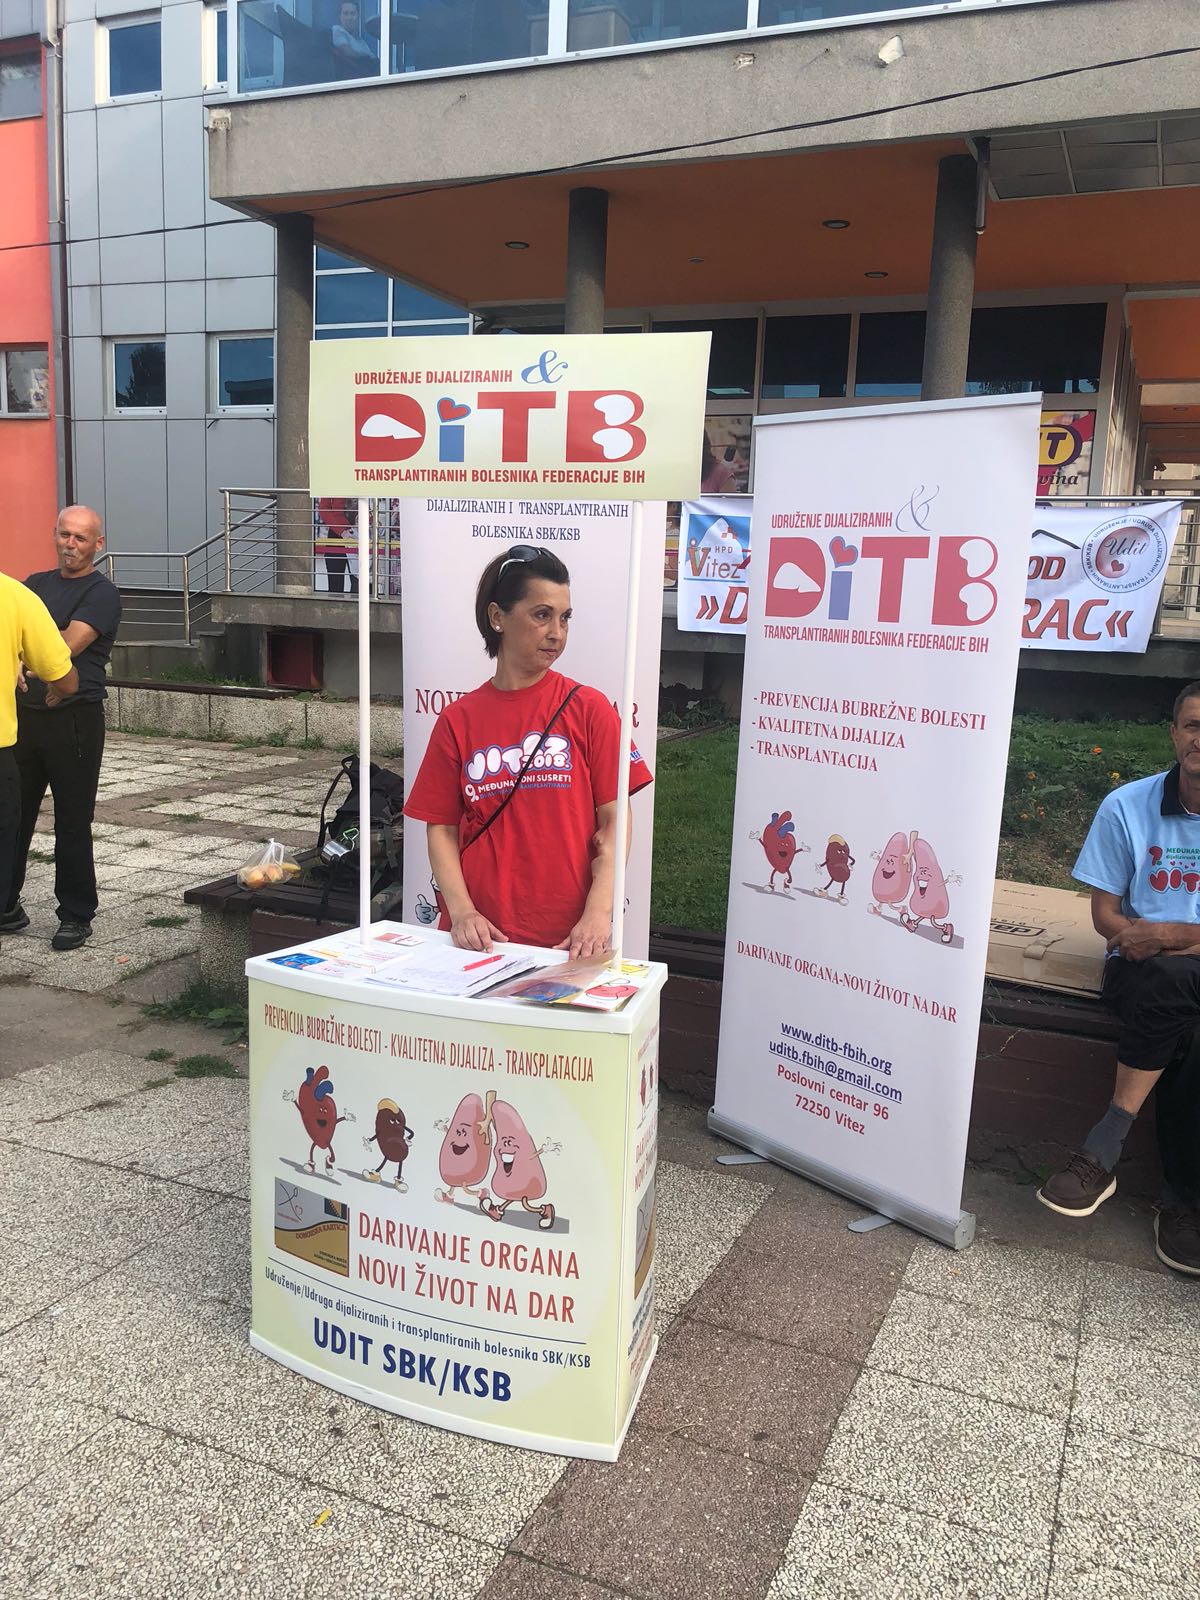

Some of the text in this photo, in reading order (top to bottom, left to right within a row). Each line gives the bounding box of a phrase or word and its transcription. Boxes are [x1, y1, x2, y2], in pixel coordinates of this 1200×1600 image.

[355, 368, 422, 384] UDRUŽENJE
[426, 369, 512, 384] DIJALIZIRANIH
[355, 468, 646, 484] TRANSPLANTIRANIH BOLESNIKA FEDERACIJE BIH
[426, 499, 629, 518] DIJALIZIRANIH I TRANSPLANTIRANIH
[772, 509, 822, 528] UDRUŽENJE
[824, 512, 893, 528] DIJALIZIRANIH
[472, 524, 580, 541] BOLESNIKA SBK/KSB
[1104, 537, 1147, 556] Udit
[688, 547, 741, 578] Vitez
[764, 625, 989, 653] TRANSPLANTIRANIH BOLESNIKA FEDERACIJE BIH
[760, 691, 838, 714] PREVENCIJA
[842, 700, 916, 722] BUBREŽNE
[920, 708, 987, 731] BOLESTI
[758, 716, 838, 740] KVALITETNA
[841, 726, 906, 749] DIJALIZA
[757, 740, 878, 772] TRANSPLANTACIJA
[536, 774, 572, 783] SUSRETI
[737, 940, 792, 970] DARIVANJE
[873, 979, 910, 1006] ŽIVOT
[913, 994, 928, 1014] NA
[931, 1001, 958, 1023] DAR
[264, 1004, 305, 1036] PREVENCIJA
[306, 1014, 345, 1048] BUBREŽNE
[348, 1025, 382, 1054] BOLESTI
[390, 1033, 446, 1066] KVALITETNA
[450, 1042, 495, 1072] DIJALIZA
[505, 1049, 594, 1083] TRANSPLATACIJA
[781, 1022, 892, 1076] www.ditb-fbih.org
[769, 1039, 902, 1102] uditb.fbih@gmail.com
[777, 1064, 890, 1120] Poslovni centar 96
[794, 1094, 866, 1136] 72250 Vitez
[358, 1212, 580, 1280] DARIVANJE ORGANA
[358, 1253, 406, 1292] NOVI
[414, 1262, 478, 1306] ŽIVOT
[487, 1286, 518, 1316] NA
[528, 1292, 575, 1324] DAR
[265, 1266, 334, 1309] Udruženje/Udruga
[336, 1297, 390, 1328] dijaliziranih
[397, 1318, 480, 1352] transplantiranih
[484, 1340, 538, 1362] bolesnika
[542, 1349, 591, 1370] SBK/KSB
[314, 1317, 512, 1402] UDIT SBK/KSB
